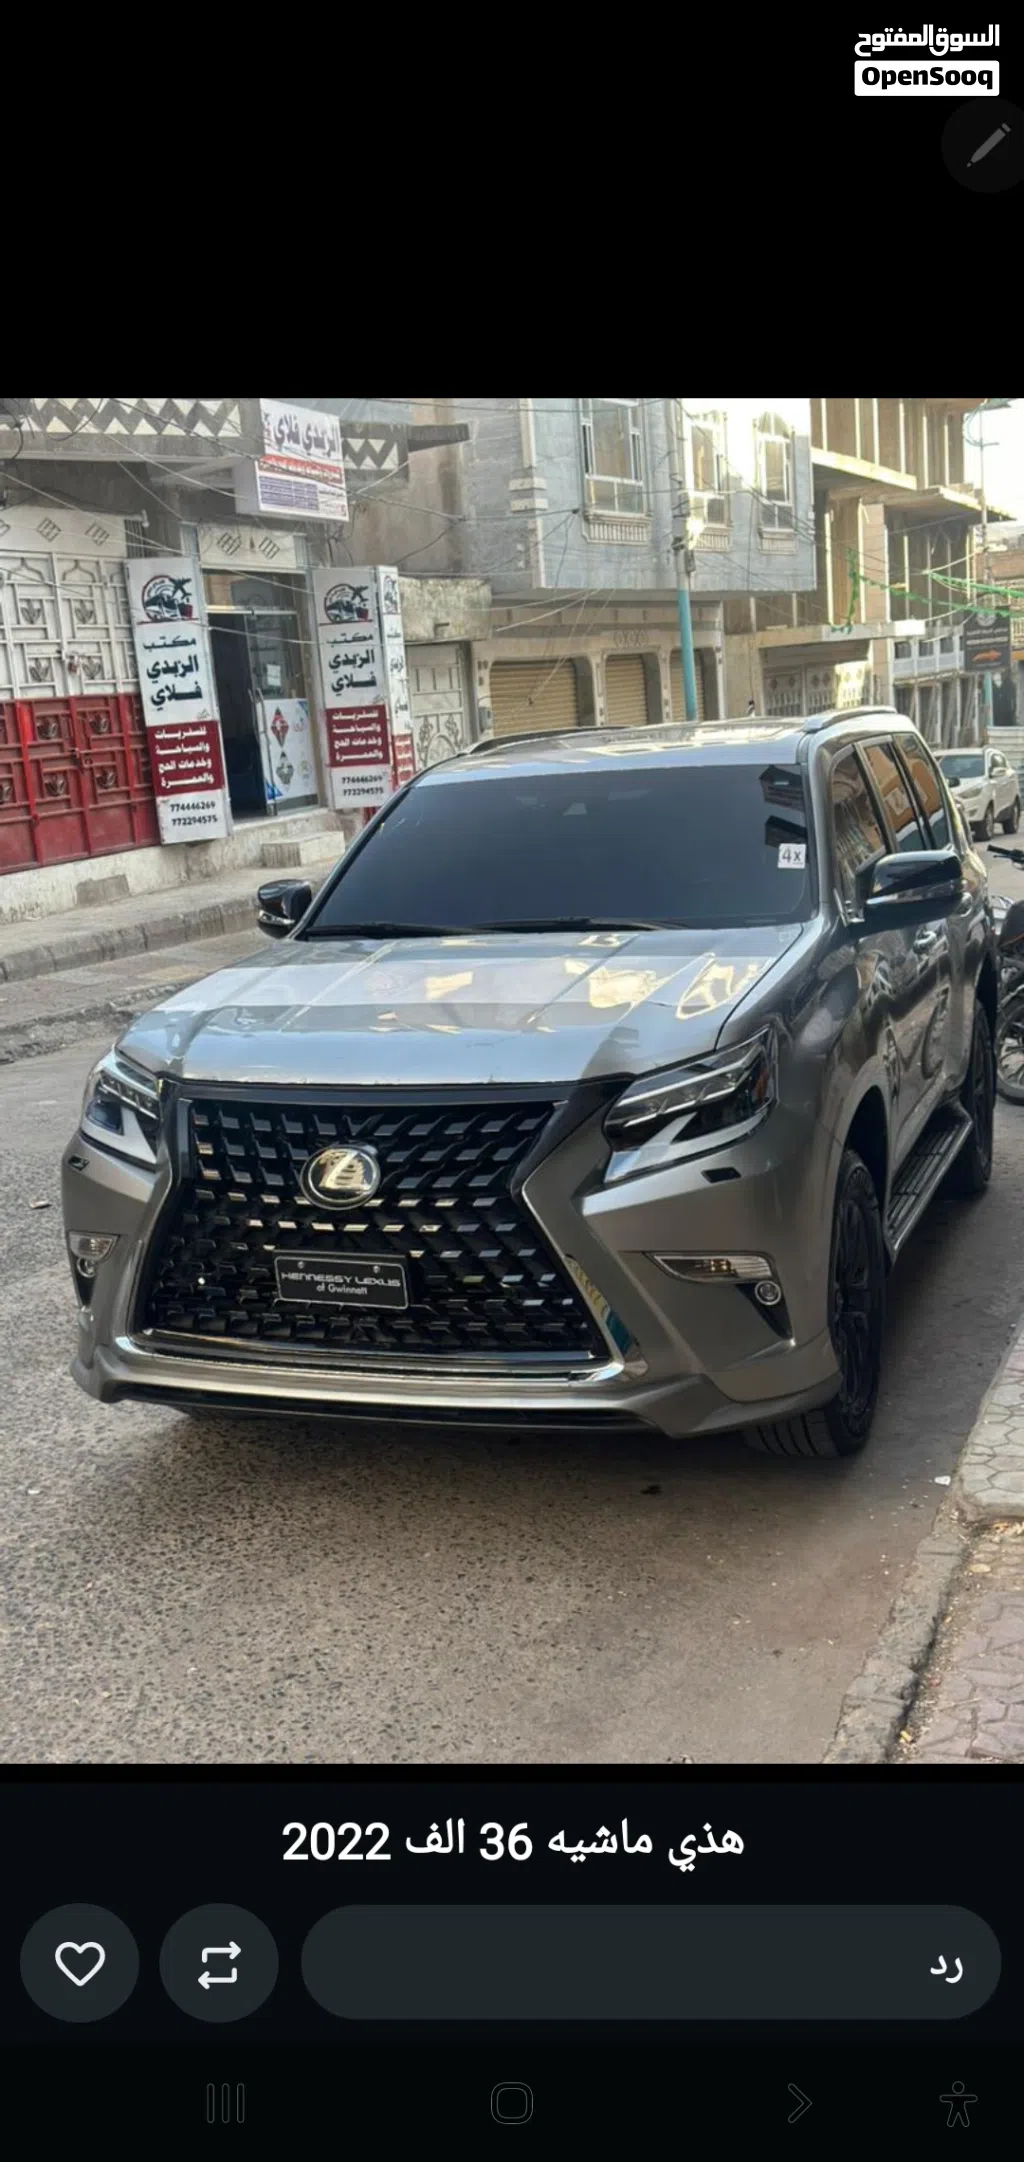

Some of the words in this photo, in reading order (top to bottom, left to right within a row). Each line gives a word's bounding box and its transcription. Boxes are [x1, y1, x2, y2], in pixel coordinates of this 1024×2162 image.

[142, 635, 197, 653] مكتب
[326, 632, 374, 648] مكتب
[331, 671, 377, 697] فلاي
[150, 680, 203, 712] فلاي
[343, 787, 385, 797] 772294575
[170, 801, 216, 813] 774446269
[171, 815, 218, 827] 772294575
[281, 1271, 353, 1283] HENNESSY
[354, 1276, 401, 1287] LEXUS
[316, 1282, 326, 1292] of
[327, 1284, 368, 1295] Gwinnett
